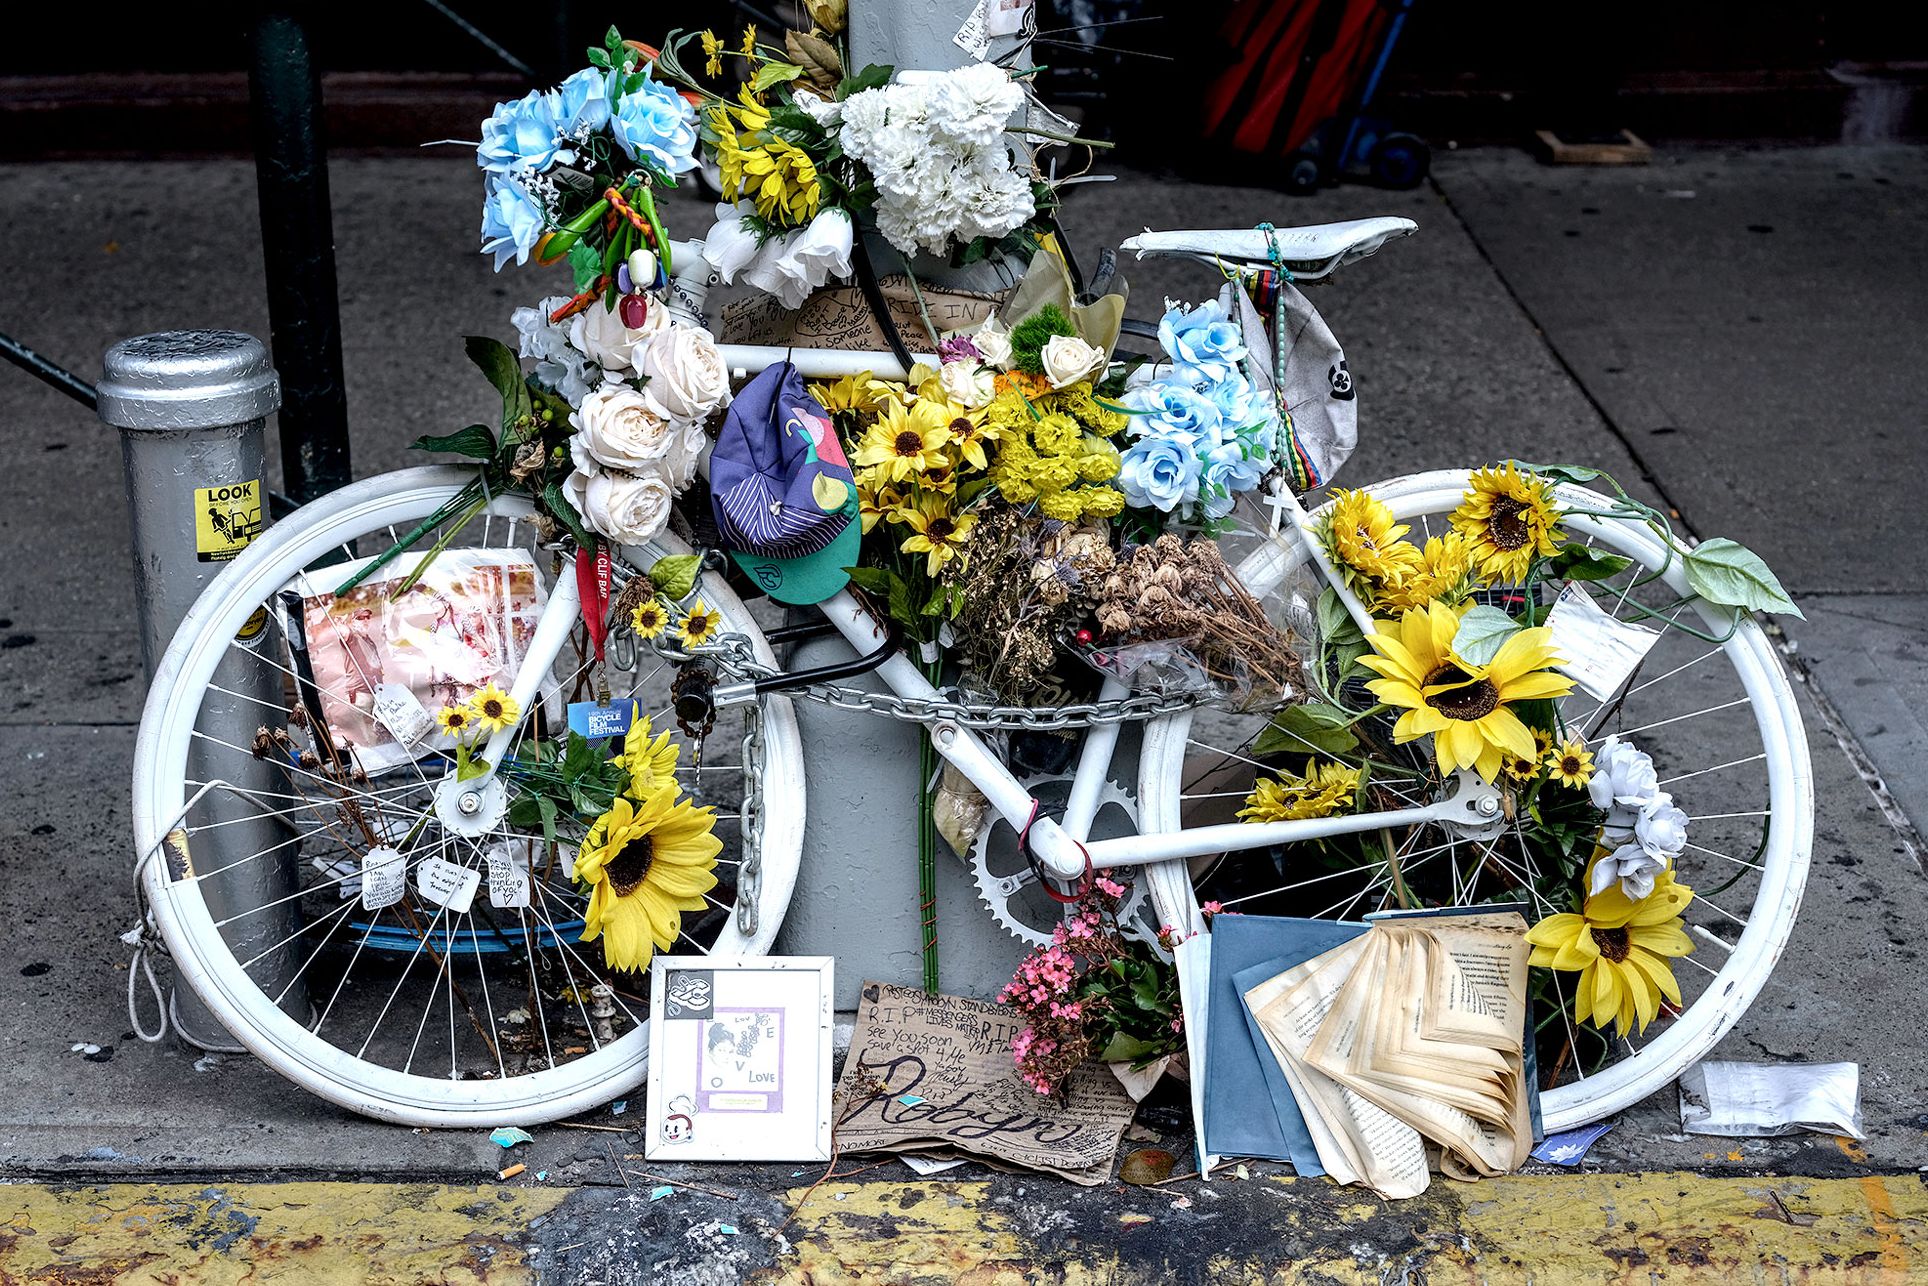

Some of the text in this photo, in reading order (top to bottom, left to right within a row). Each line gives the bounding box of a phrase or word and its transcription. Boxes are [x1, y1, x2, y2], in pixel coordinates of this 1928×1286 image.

[944, 302, 978, 321] IN
[208, 483, 252, 502] LOOK
[597, 544, 608, 599] BY CLIF BAR
[589, 713, 621, 722] BICYCLE
[589, 721, 608, 730] FILM
[589, 725, 626, 735] FESTIVAL
[926, 1015, 954, 1029] LIVES
[936, 1047, 944, 1061] 4
[749, 1070, 775, 1083] LOVE
[838, 1048, 1082, 1143] Robyn
